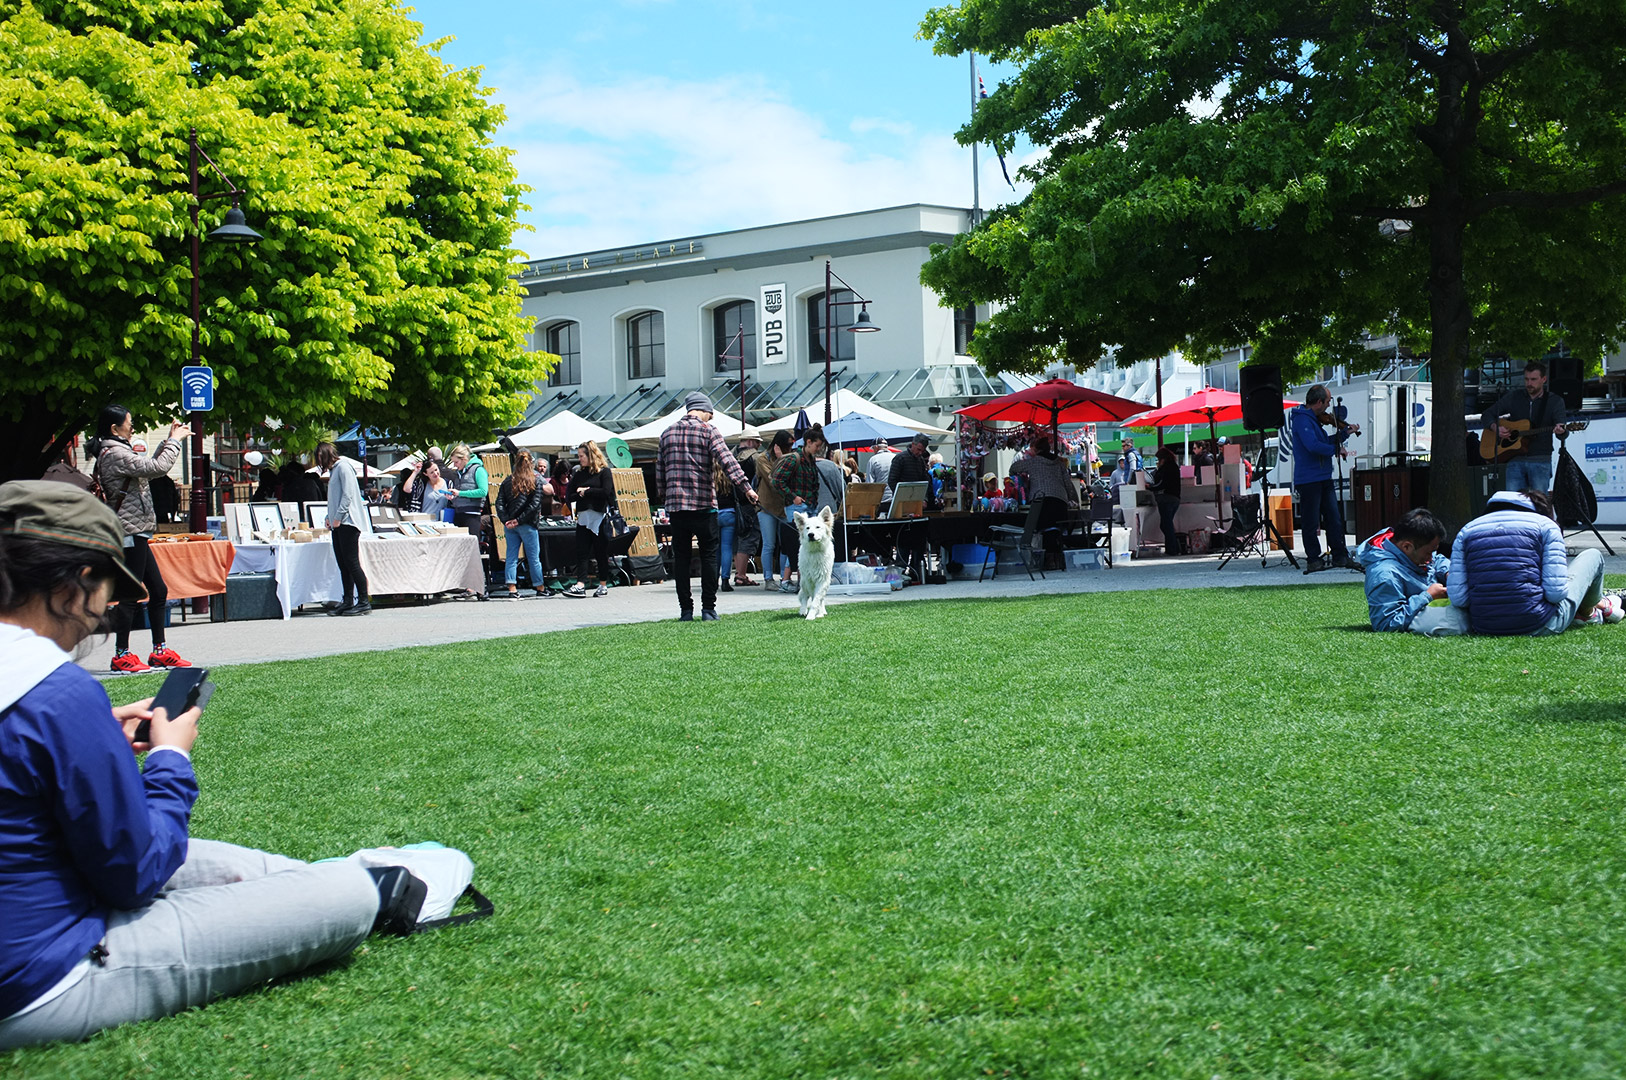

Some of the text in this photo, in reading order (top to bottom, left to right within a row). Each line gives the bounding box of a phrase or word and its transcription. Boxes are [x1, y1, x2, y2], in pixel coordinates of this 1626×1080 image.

[615, 241, 695, 264] WHARF
[765, 293, 782, 305] PUB
[765, 319, 784, 358] PUB
[1586, 446, 1596, 455] For
[1597, 445, 1614, 454] Lease
